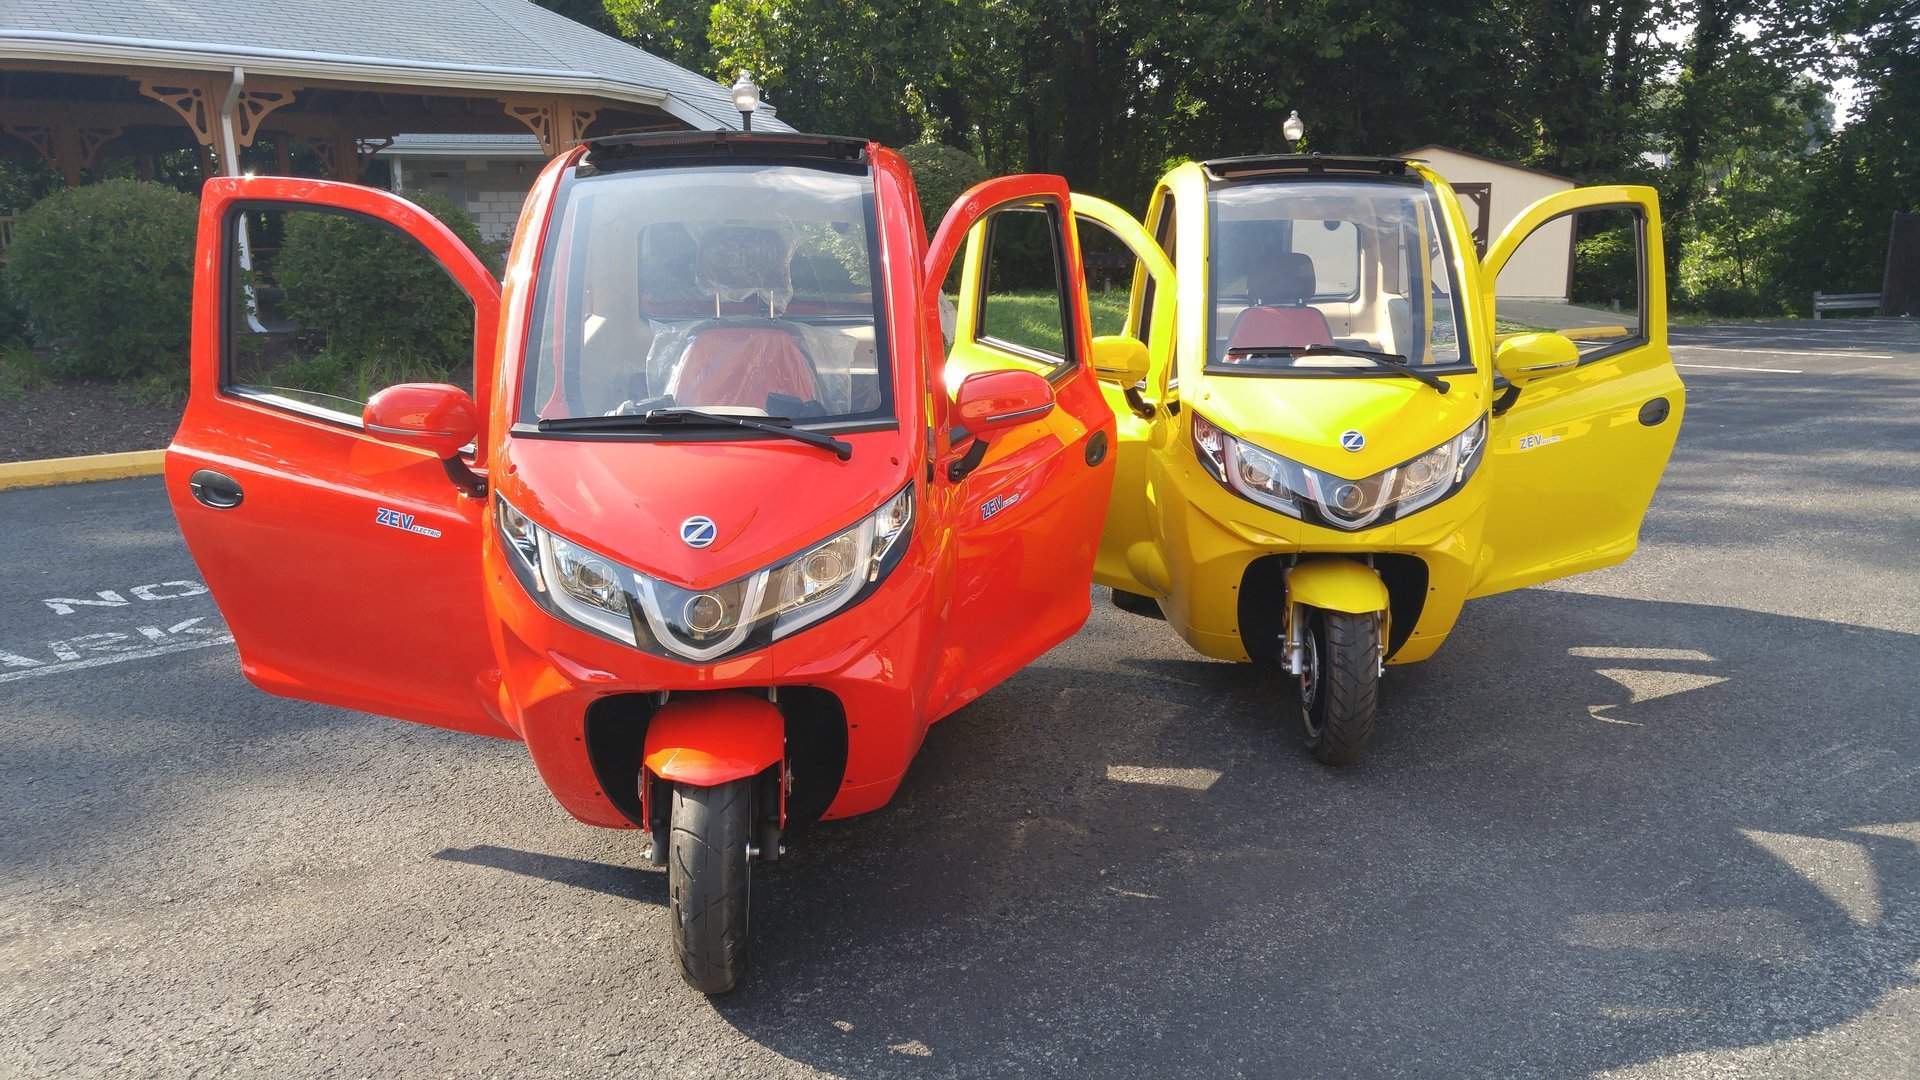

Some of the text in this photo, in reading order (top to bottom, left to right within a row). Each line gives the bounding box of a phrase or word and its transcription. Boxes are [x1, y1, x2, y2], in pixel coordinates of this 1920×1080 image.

[1519, 434, 1542, 450] ZEV
[981, 495, 1002, 519] ZEV
[377, 507, 441, 538] ZEV ELECTRIC
[42, 580, 209, 615] NO
